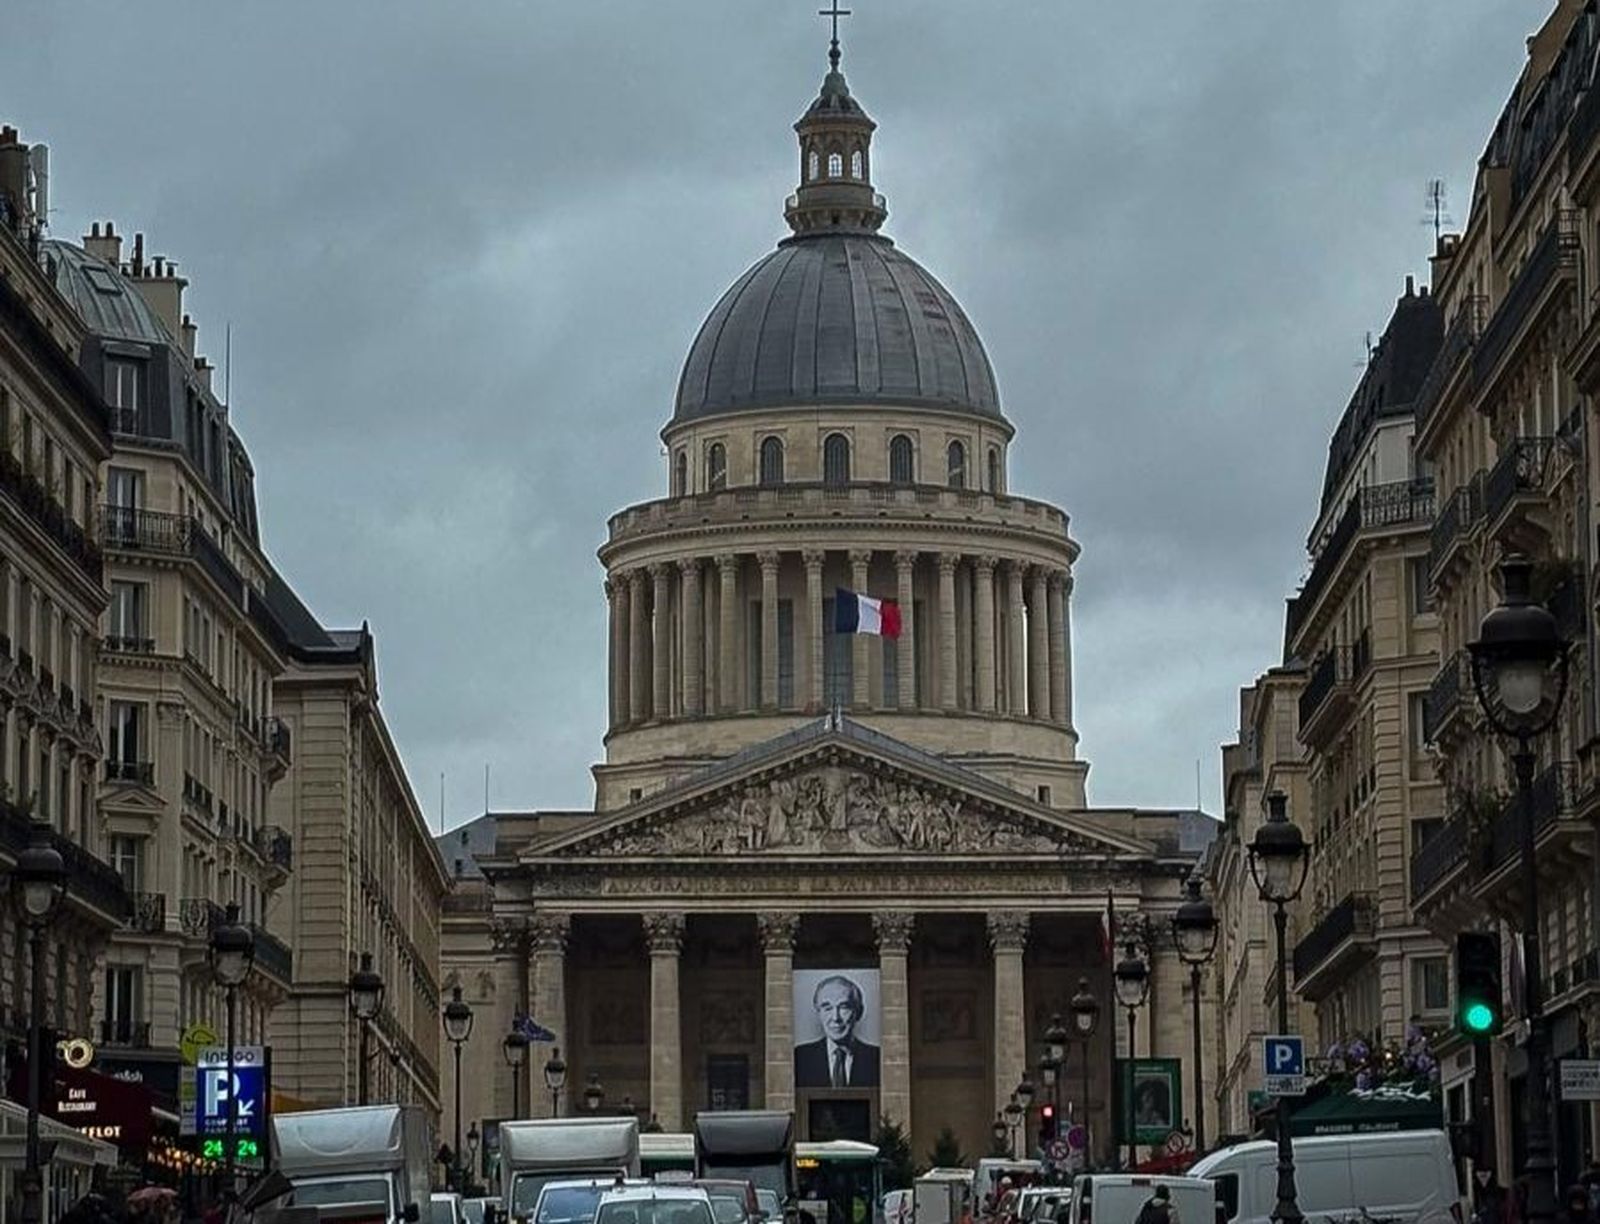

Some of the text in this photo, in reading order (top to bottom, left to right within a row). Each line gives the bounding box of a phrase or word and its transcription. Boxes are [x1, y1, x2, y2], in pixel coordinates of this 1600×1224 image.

[1275, 1044, 1293, 1070] P
[205, 1070, 240, 1116] P
[203, 1140, 223, 1157] 24
[238, 1140, 257, 1156] 24
